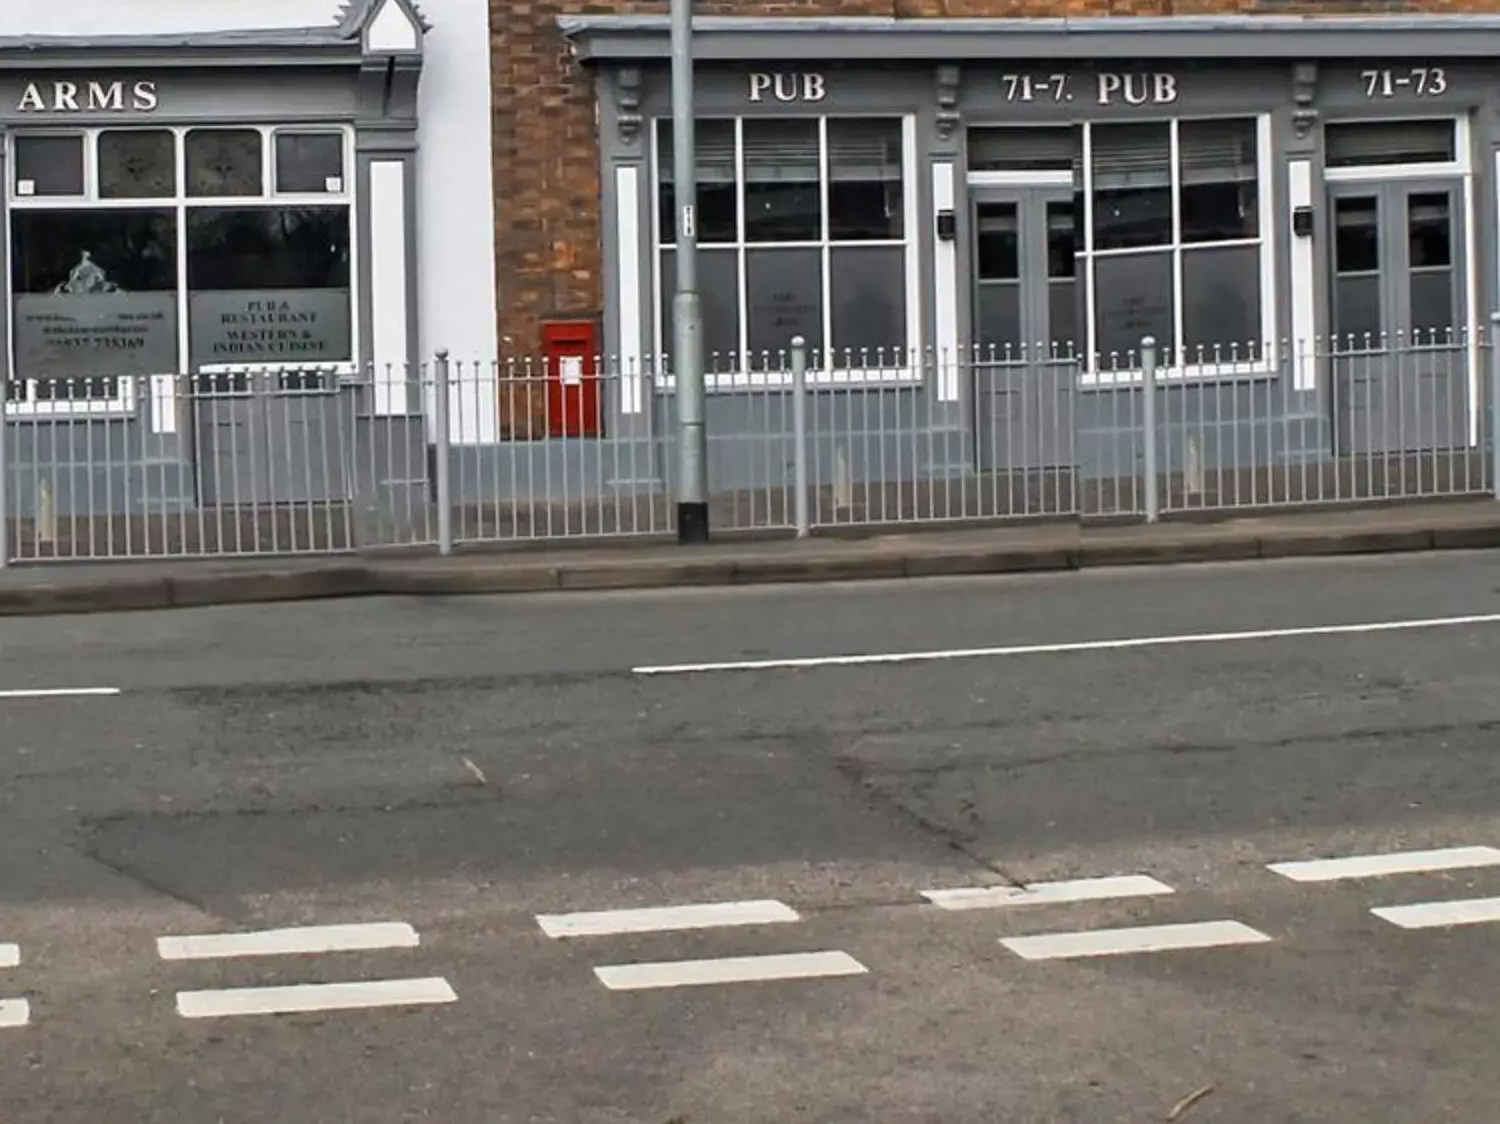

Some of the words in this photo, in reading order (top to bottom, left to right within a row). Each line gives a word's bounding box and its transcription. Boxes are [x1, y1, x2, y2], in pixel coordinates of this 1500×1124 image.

[16, 80, 160, 112] ARMS
[748, 74, 826, 102] PUB
[1097, 74, 1178, 105] PUB
[1362, 69, 1448, 97] 71-73
